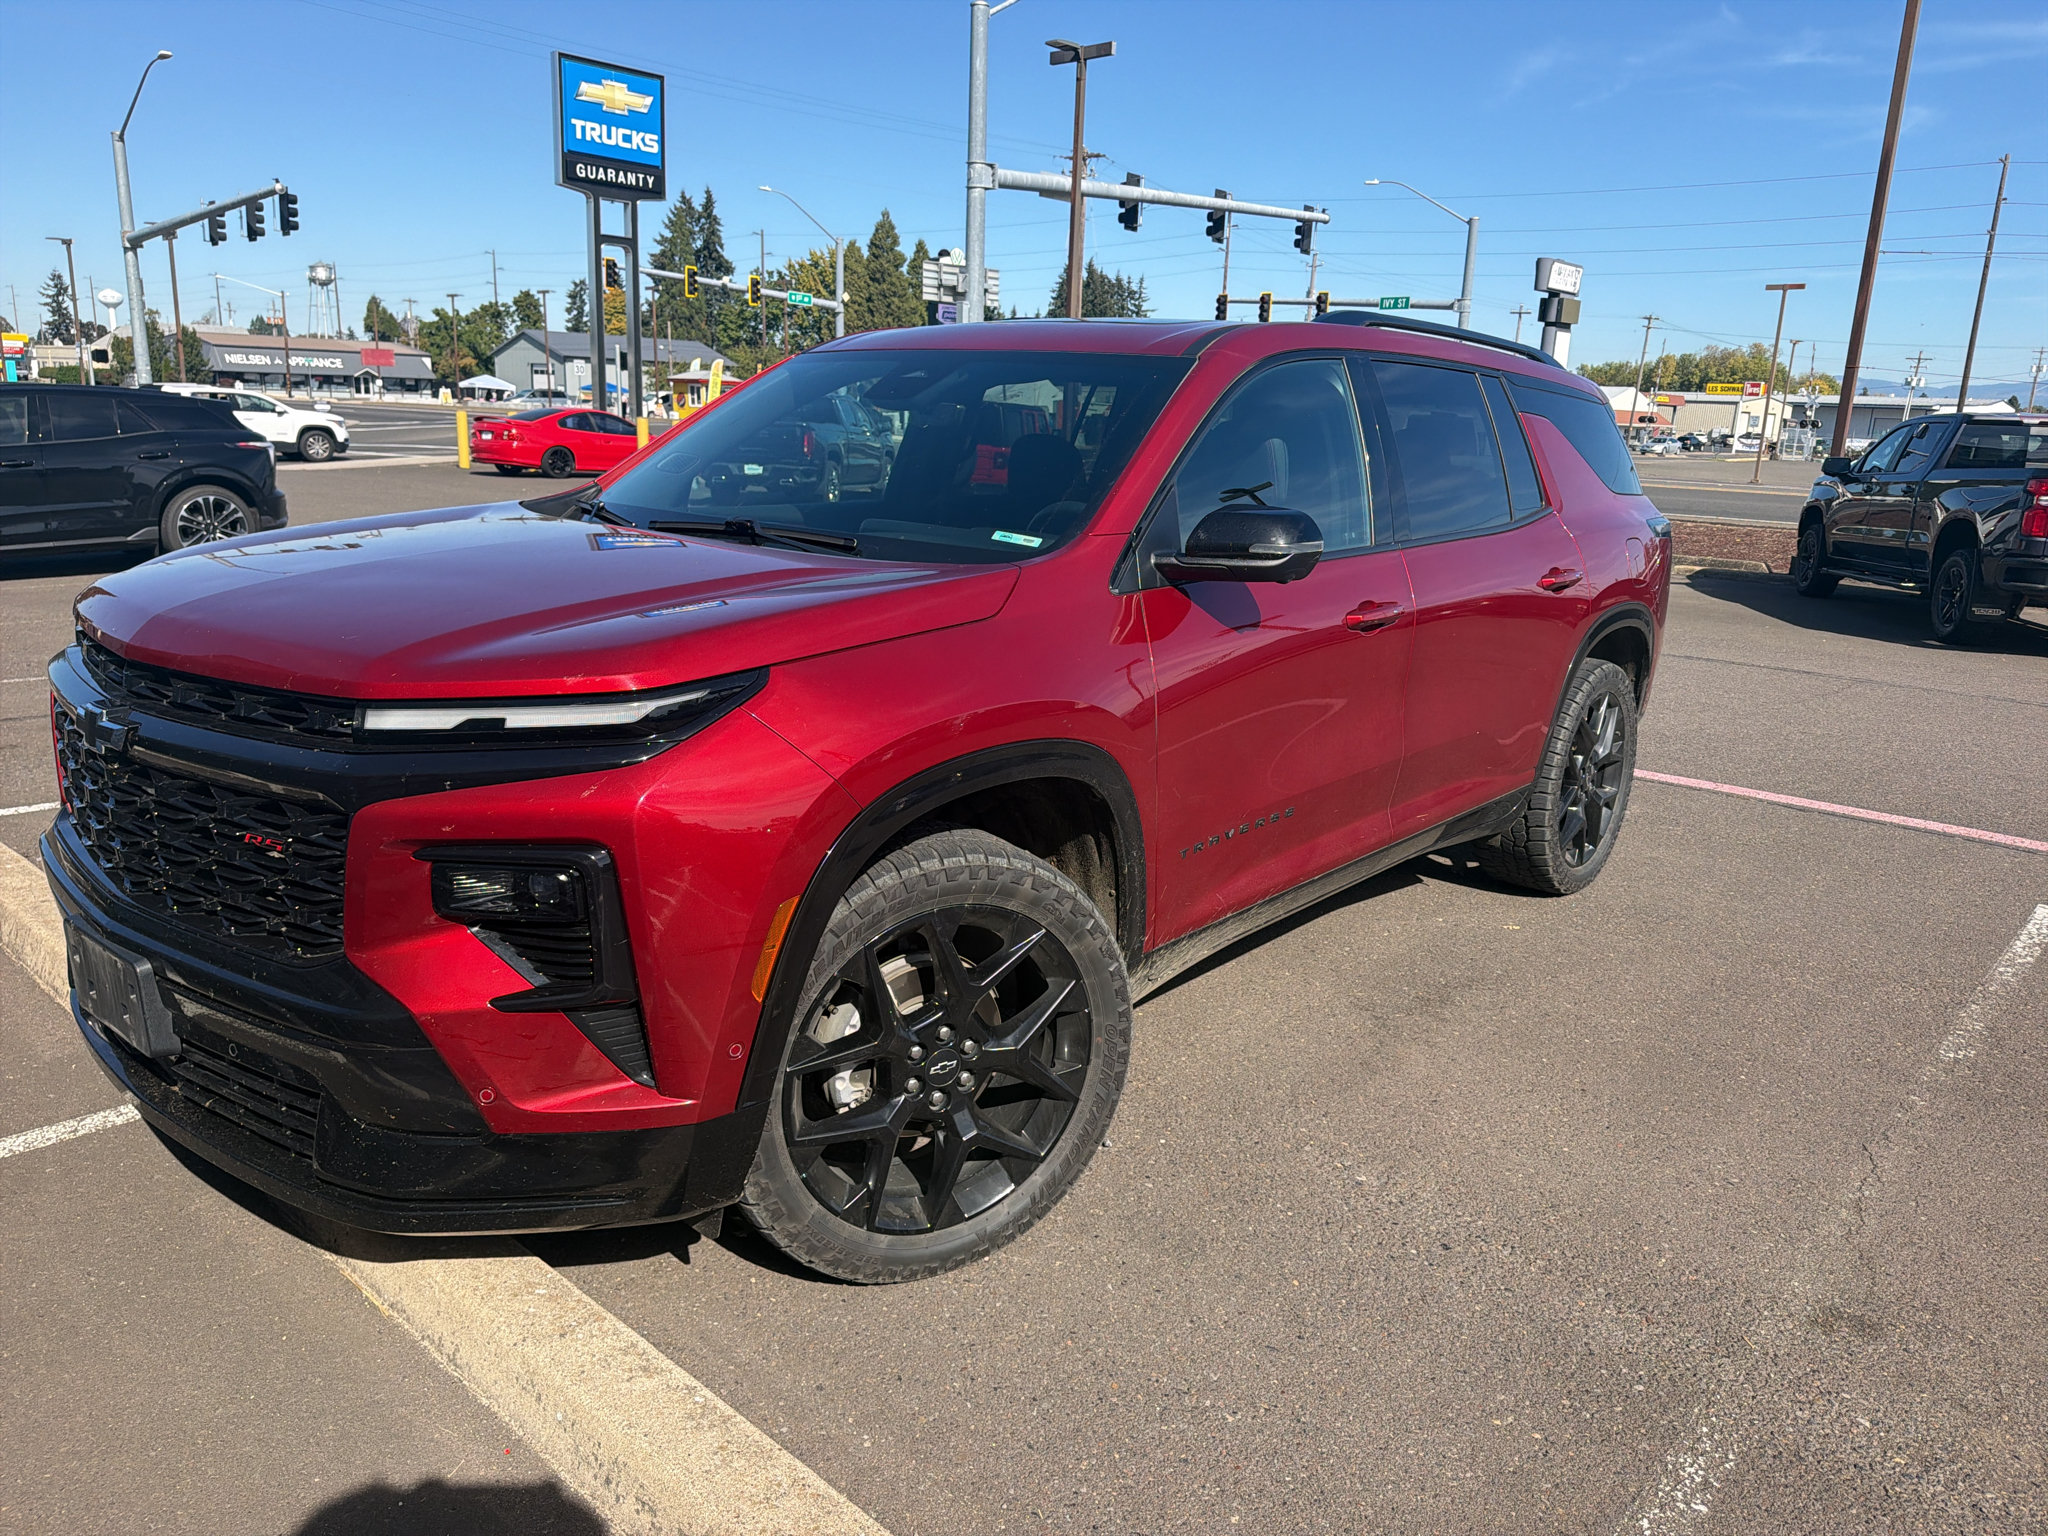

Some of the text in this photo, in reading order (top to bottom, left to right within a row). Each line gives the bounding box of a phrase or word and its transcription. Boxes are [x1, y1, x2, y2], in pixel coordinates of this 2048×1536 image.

[571, 118, 659, 154] TRUCKS
[575, 163, 655, 189] GUARANTY
[1382, 298, 1407, 308] IVY ST
[224, 353, 272, 366] NIELSEN
[575, 365, 585, 374] 30
[243, 833, 284, 852] RS
[1179, 806, 1295, 859] TRAVERSE
[1101, 1023, 1119, 1095] OPEN
